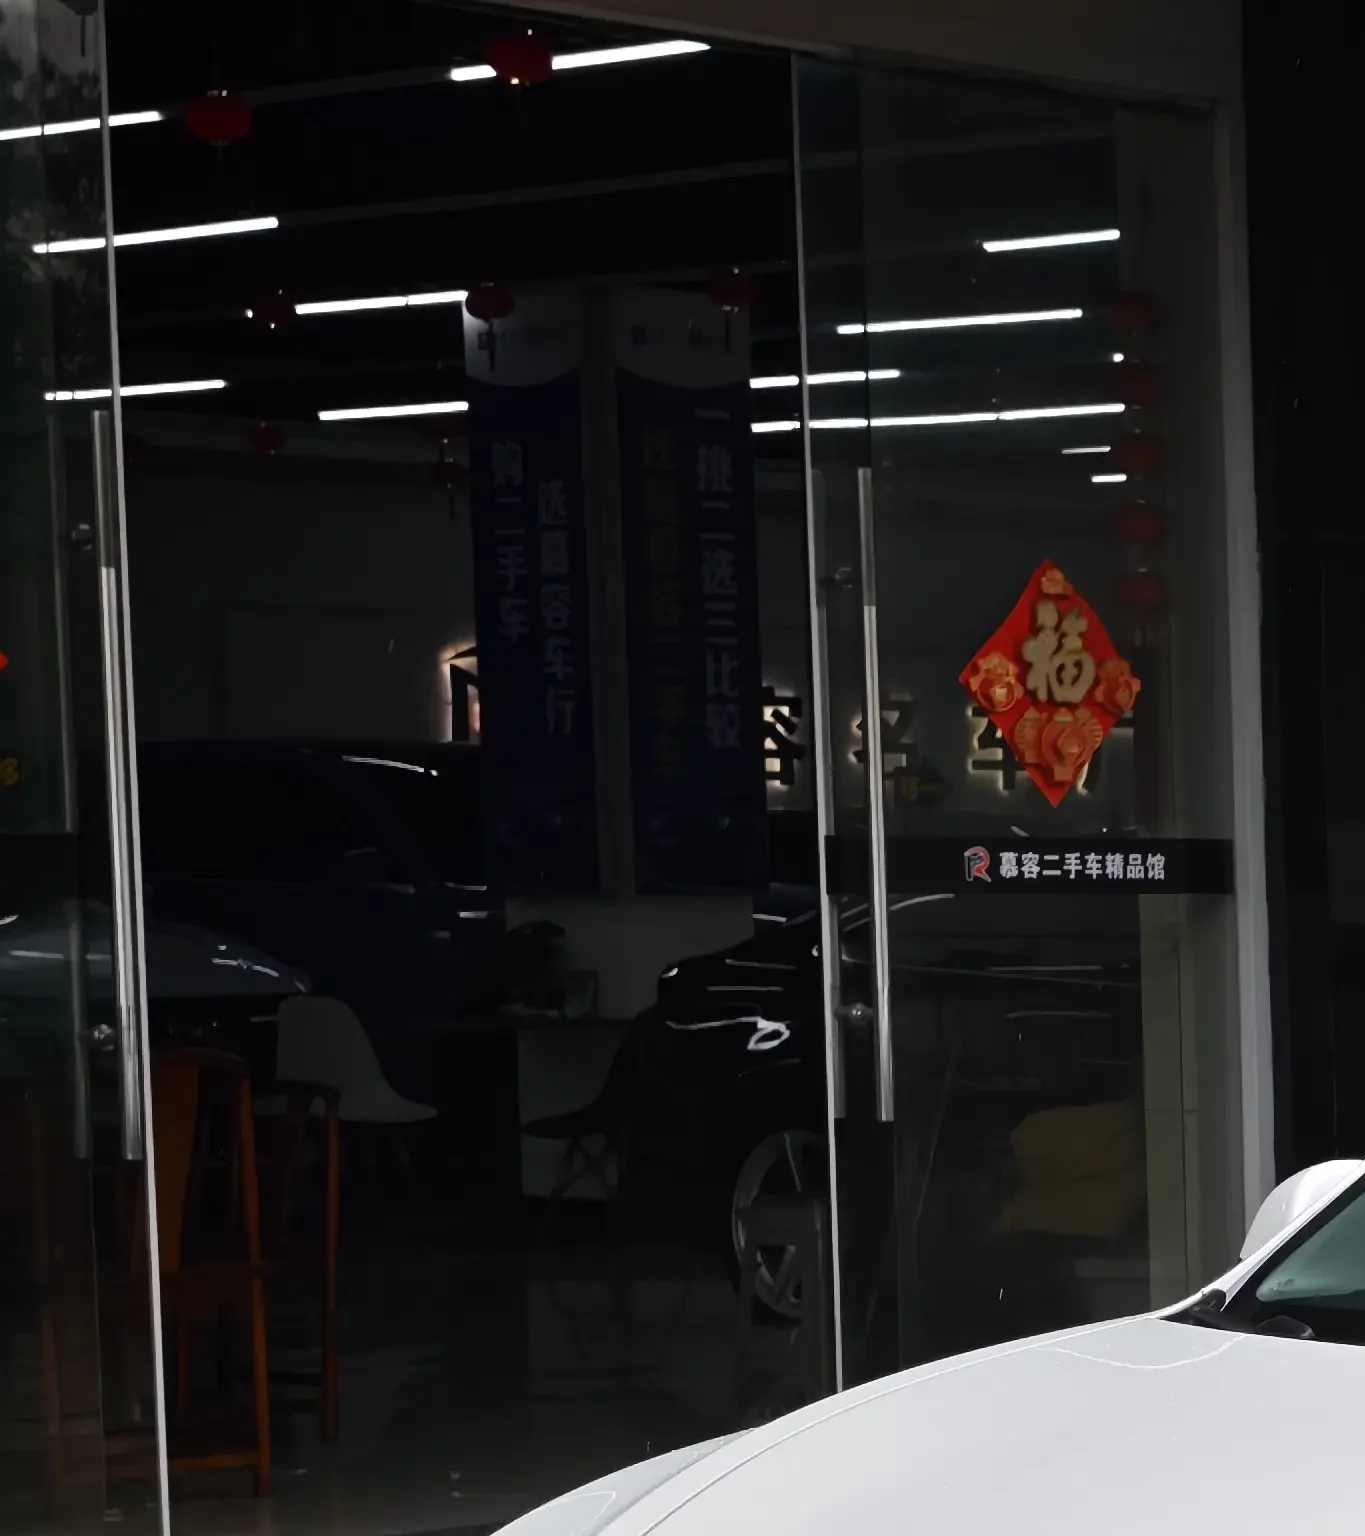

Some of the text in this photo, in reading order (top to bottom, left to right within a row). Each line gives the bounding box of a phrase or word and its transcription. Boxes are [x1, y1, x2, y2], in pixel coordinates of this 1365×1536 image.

[1020, 598, 1097, 704] 福
[998, 851, 1167, 881] 慕容二手车精品馆
